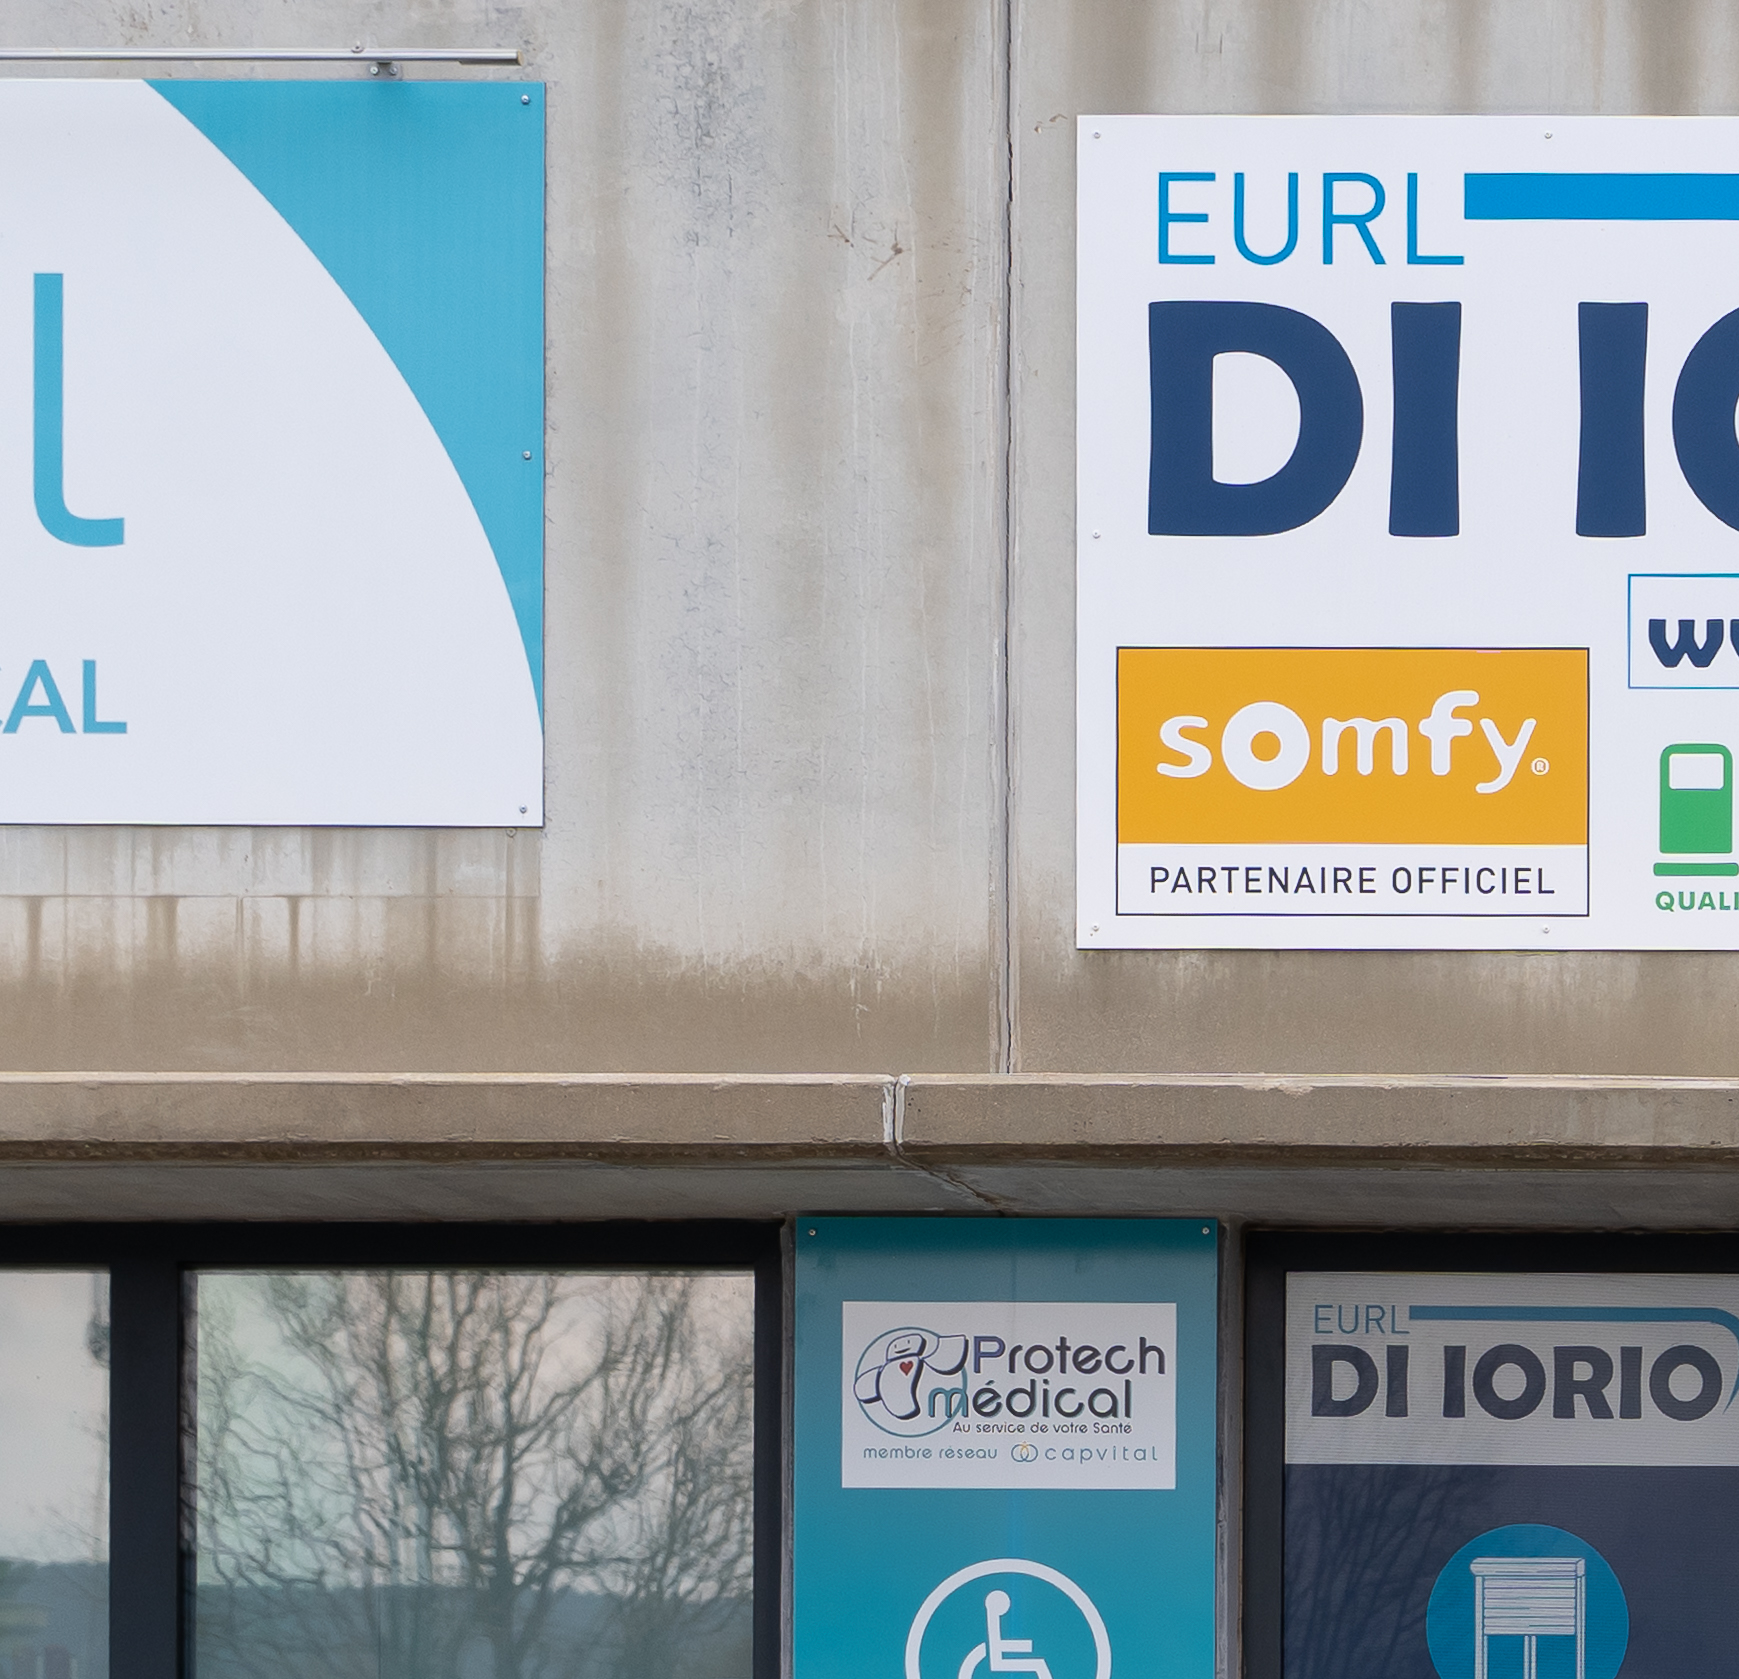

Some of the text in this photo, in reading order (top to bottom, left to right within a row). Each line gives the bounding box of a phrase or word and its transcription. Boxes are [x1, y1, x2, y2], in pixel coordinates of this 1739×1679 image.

[1157, 172, 1464, 266] EURL
[1148, 301, 1461, 538] DI
[0, 659, 128, 734] AL
[1157, 690, 1537, 793] somfy
[1151, 867, 1554, 895] PARTENAIRE OFFICIEL
[1314, 1304, 1410, 1334] EURL
[973, 1336, 1165, 1375] Protech
[928, 1379, 1131, 1419] médical
[1311, 1344, 1723, 1421] DI IORIO
[953, 1422, 1131, 1434] Au service de votre Santé
[863, 1445, 1157, 1464] membre réseau capvital
